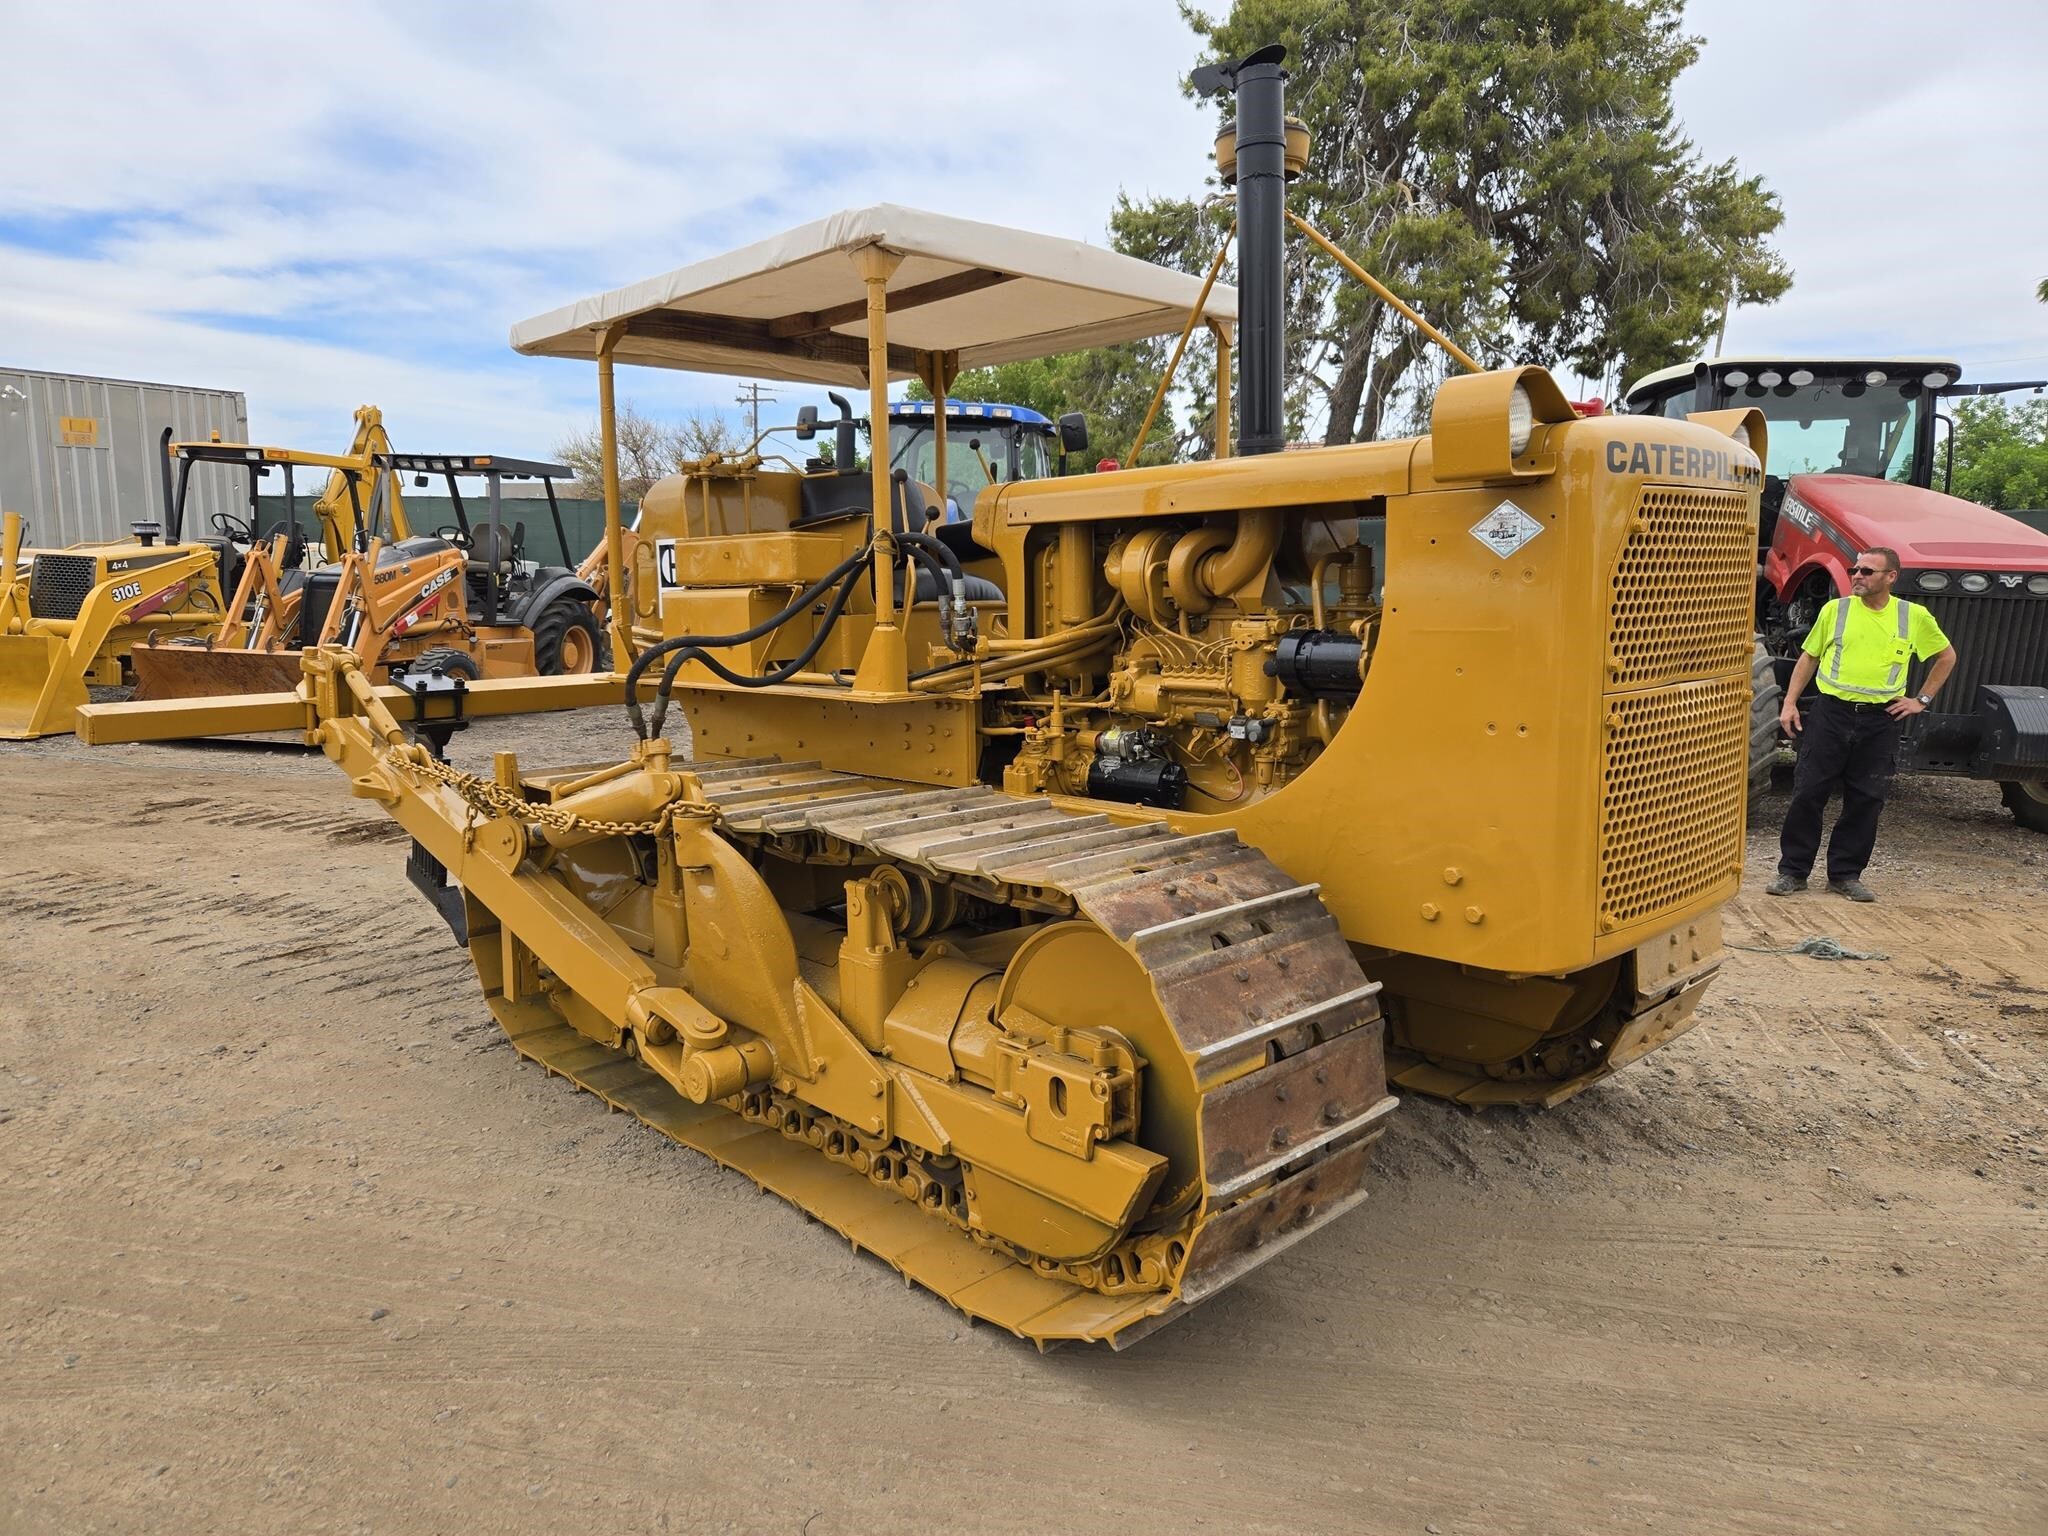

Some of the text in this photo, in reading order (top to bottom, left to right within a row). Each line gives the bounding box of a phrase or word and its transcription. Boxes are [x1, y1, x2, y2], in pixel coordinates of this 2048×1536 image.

[1606, 441, 1760, 486] CATERPILLAR
[374, 569, 397, 585] 580M
[421, 568, 452, 598] CASE
[111, 581, 142, 602] 310E
